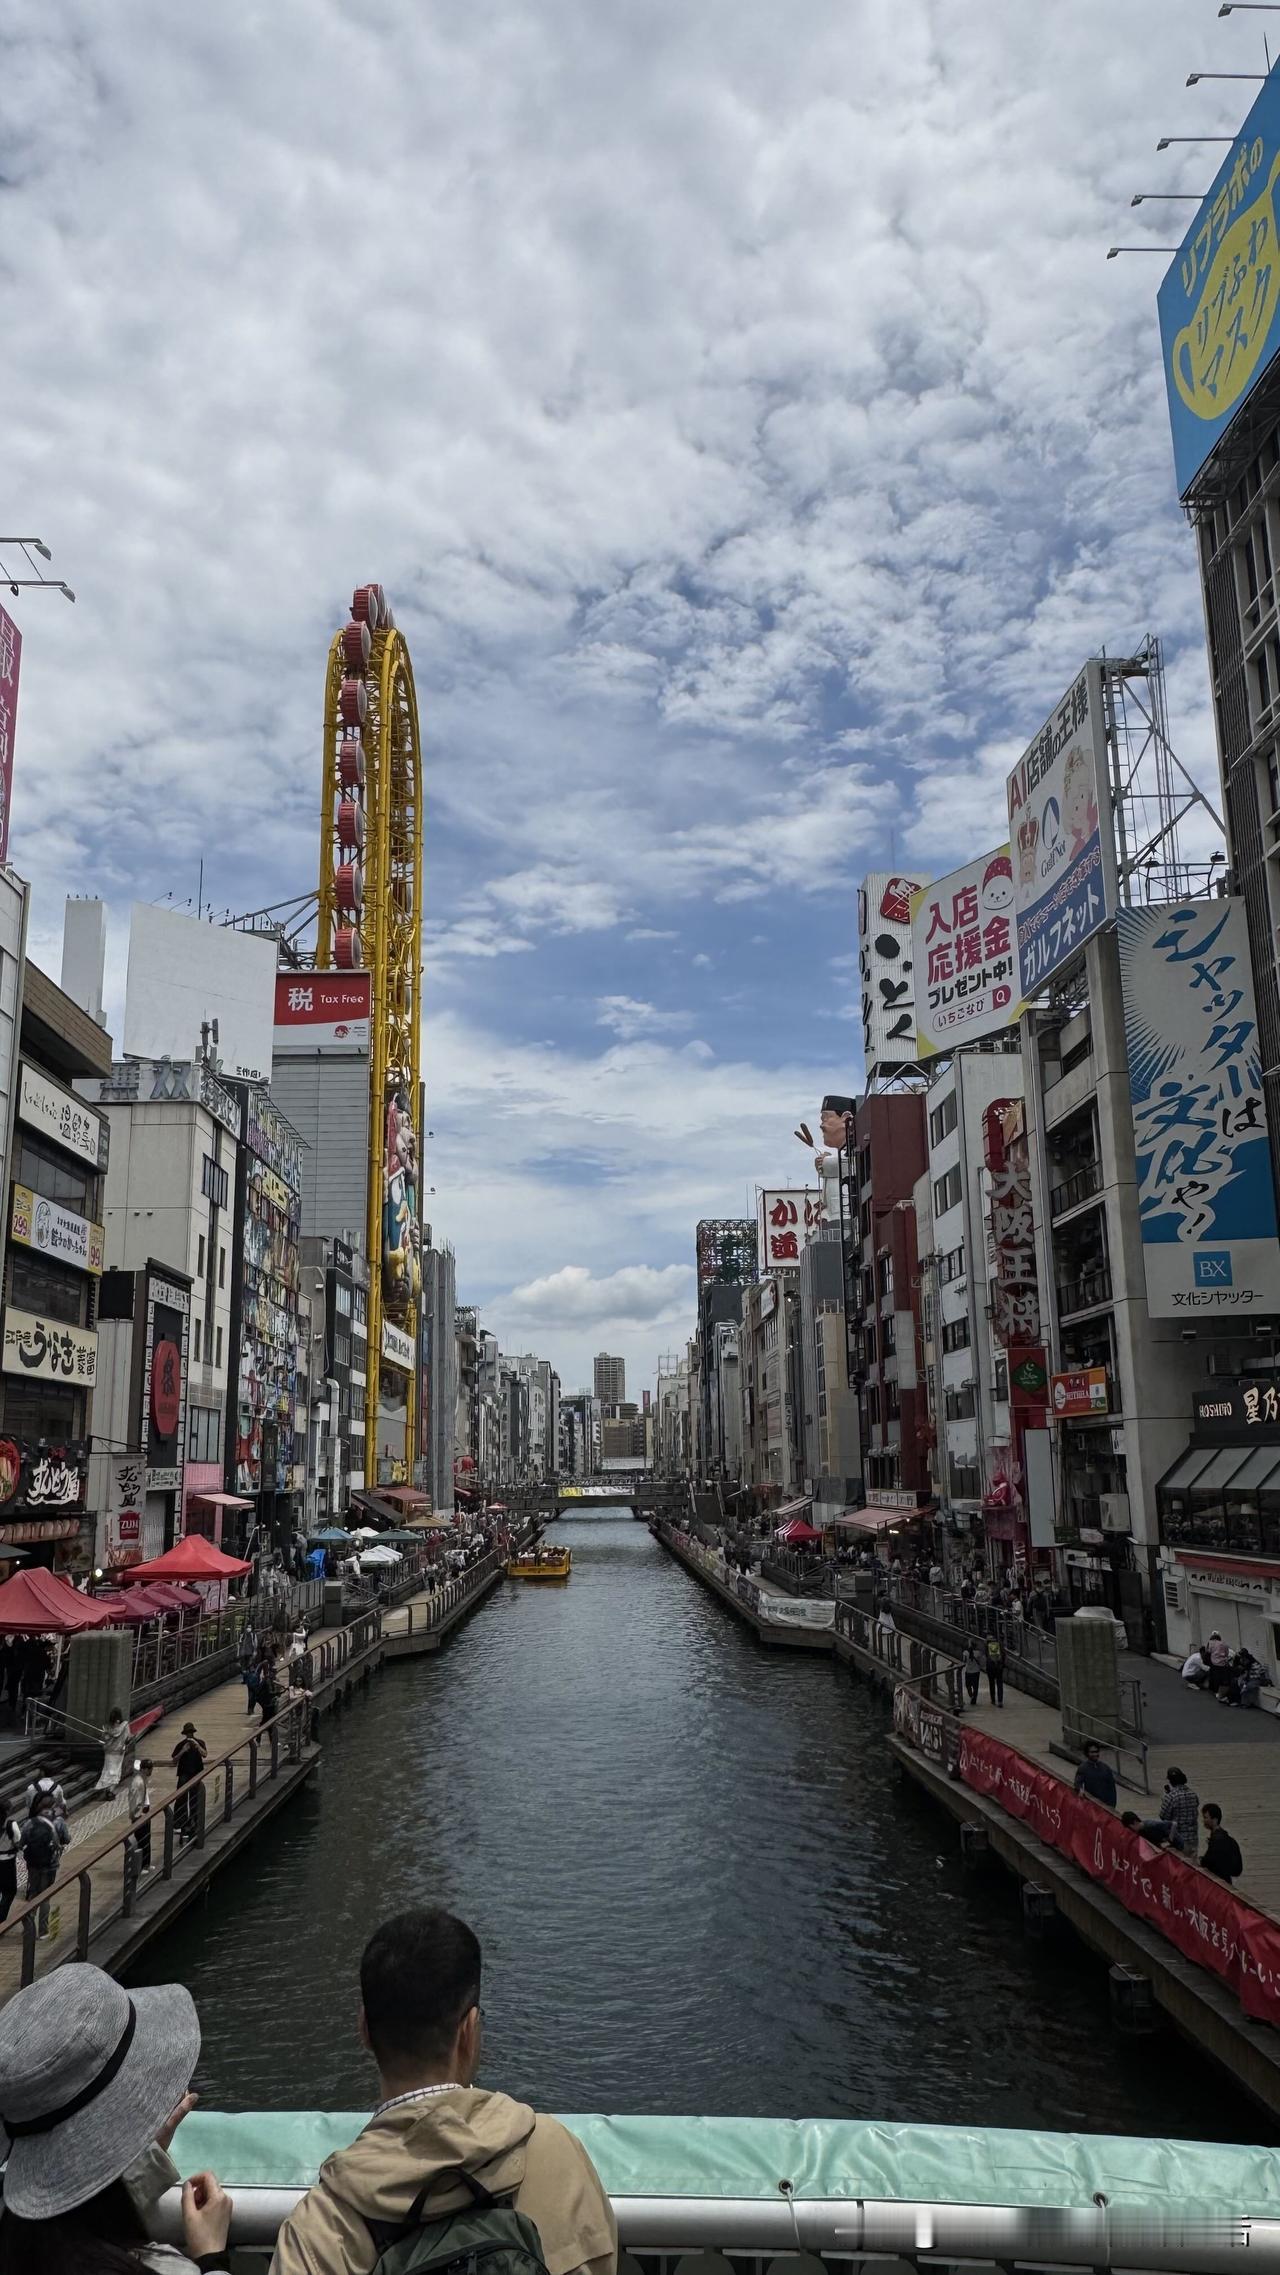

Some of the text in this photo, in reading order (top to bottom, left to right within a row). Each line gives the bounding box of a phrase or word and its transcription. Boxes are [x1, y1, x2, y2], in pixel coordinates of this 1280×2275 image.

[1200, 263, 1272, 399] マスク
[925, 884, 979, 944] 入店
[1023, 883, 1100, 986] ガルフネット
[928, 915, 1011, 987] 応援金
[288, 987, 314, 1012] 税
[320, 994, 364, 1004] Tax Free
[928, 956, 1014, 1010] プレゼント中!
[938, 998, 985, 1028] いちごなび
[769, 1198, 826, 1227] かに
[985, 1160, 1040, 1338] 大阪王将
[1200, 1260, 1227, 1278] BX
[19, 1321, 76, 1377] うなぎ
[1199, 1402, 1233, 1418] HOSHINO
[1243, 1387, 1280, 1425] 星乃
